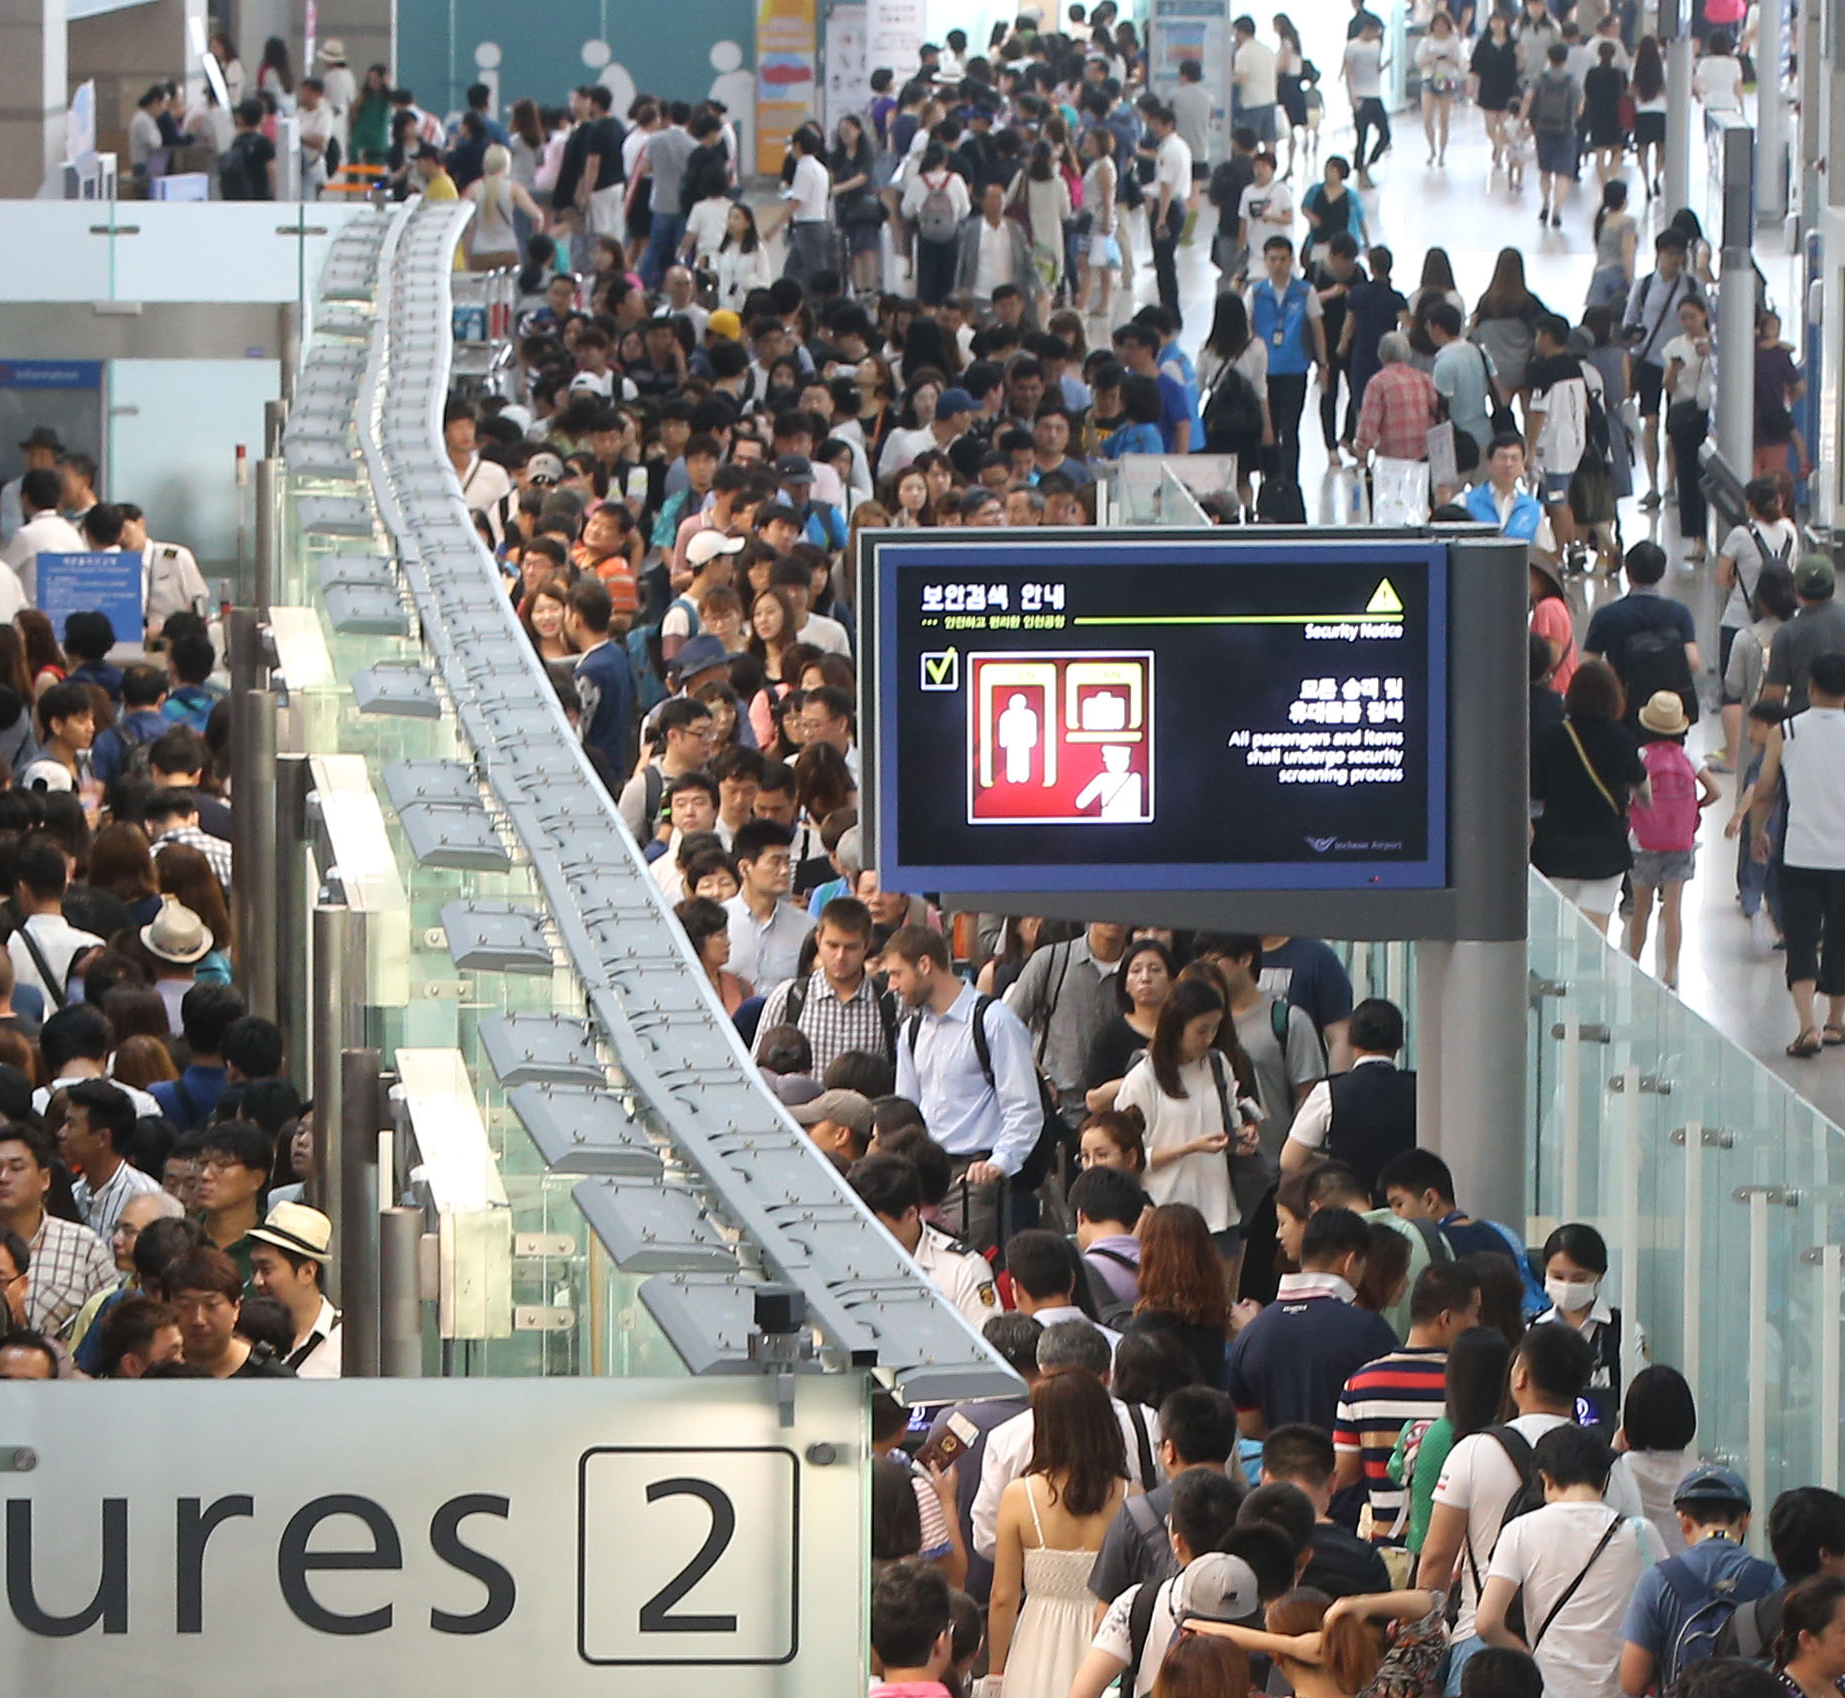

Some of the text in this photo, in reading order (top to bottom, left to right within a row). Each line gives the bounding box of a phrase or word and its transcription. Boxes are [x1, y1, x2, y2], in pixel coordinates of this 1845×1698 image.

[921, 583, 1066, 612] 보안검색 안내
[1305, 623, 1403, 642] Security Notice
[1228, 730, 1250, 747] All
[1252, 732, 1331, 750] passengers
[1333, 729, 1362, 746] and
[1247, 748, 1404, 767] shall undergo security
[1279, 767, 1404, 786] screening process
[638, 1477, 739, 1633] 2
